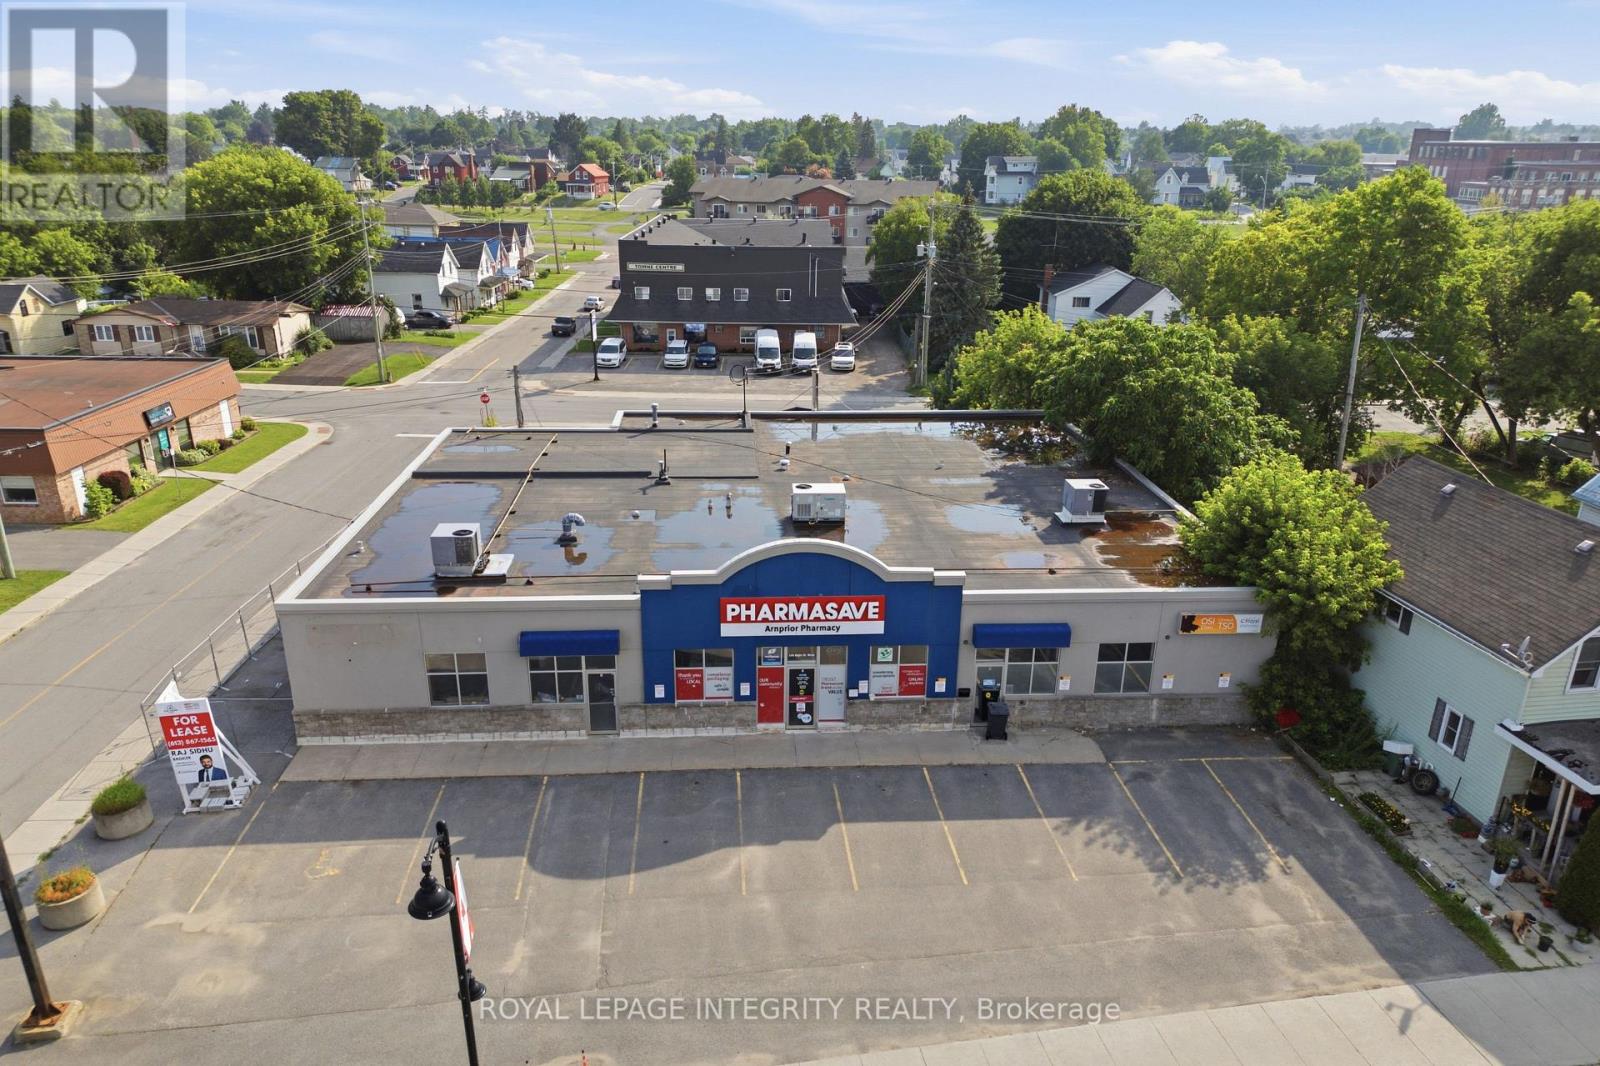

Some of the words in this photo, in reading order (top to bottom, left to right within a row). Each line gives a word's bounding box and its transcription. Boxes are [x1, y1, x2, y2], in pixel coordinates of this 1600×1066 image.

[726, 601, 880, 621] PHARMASAVE
[765, 625, 799, 633] Arnprior
[800, 624, 841, 633] Pharmacy
[173, 715, 199, 727] FOR
[169, 725, 208, 738] LEASE
[171, 749, 188, 757] RAJ
[189, 747, 213, 755] SIDHU
